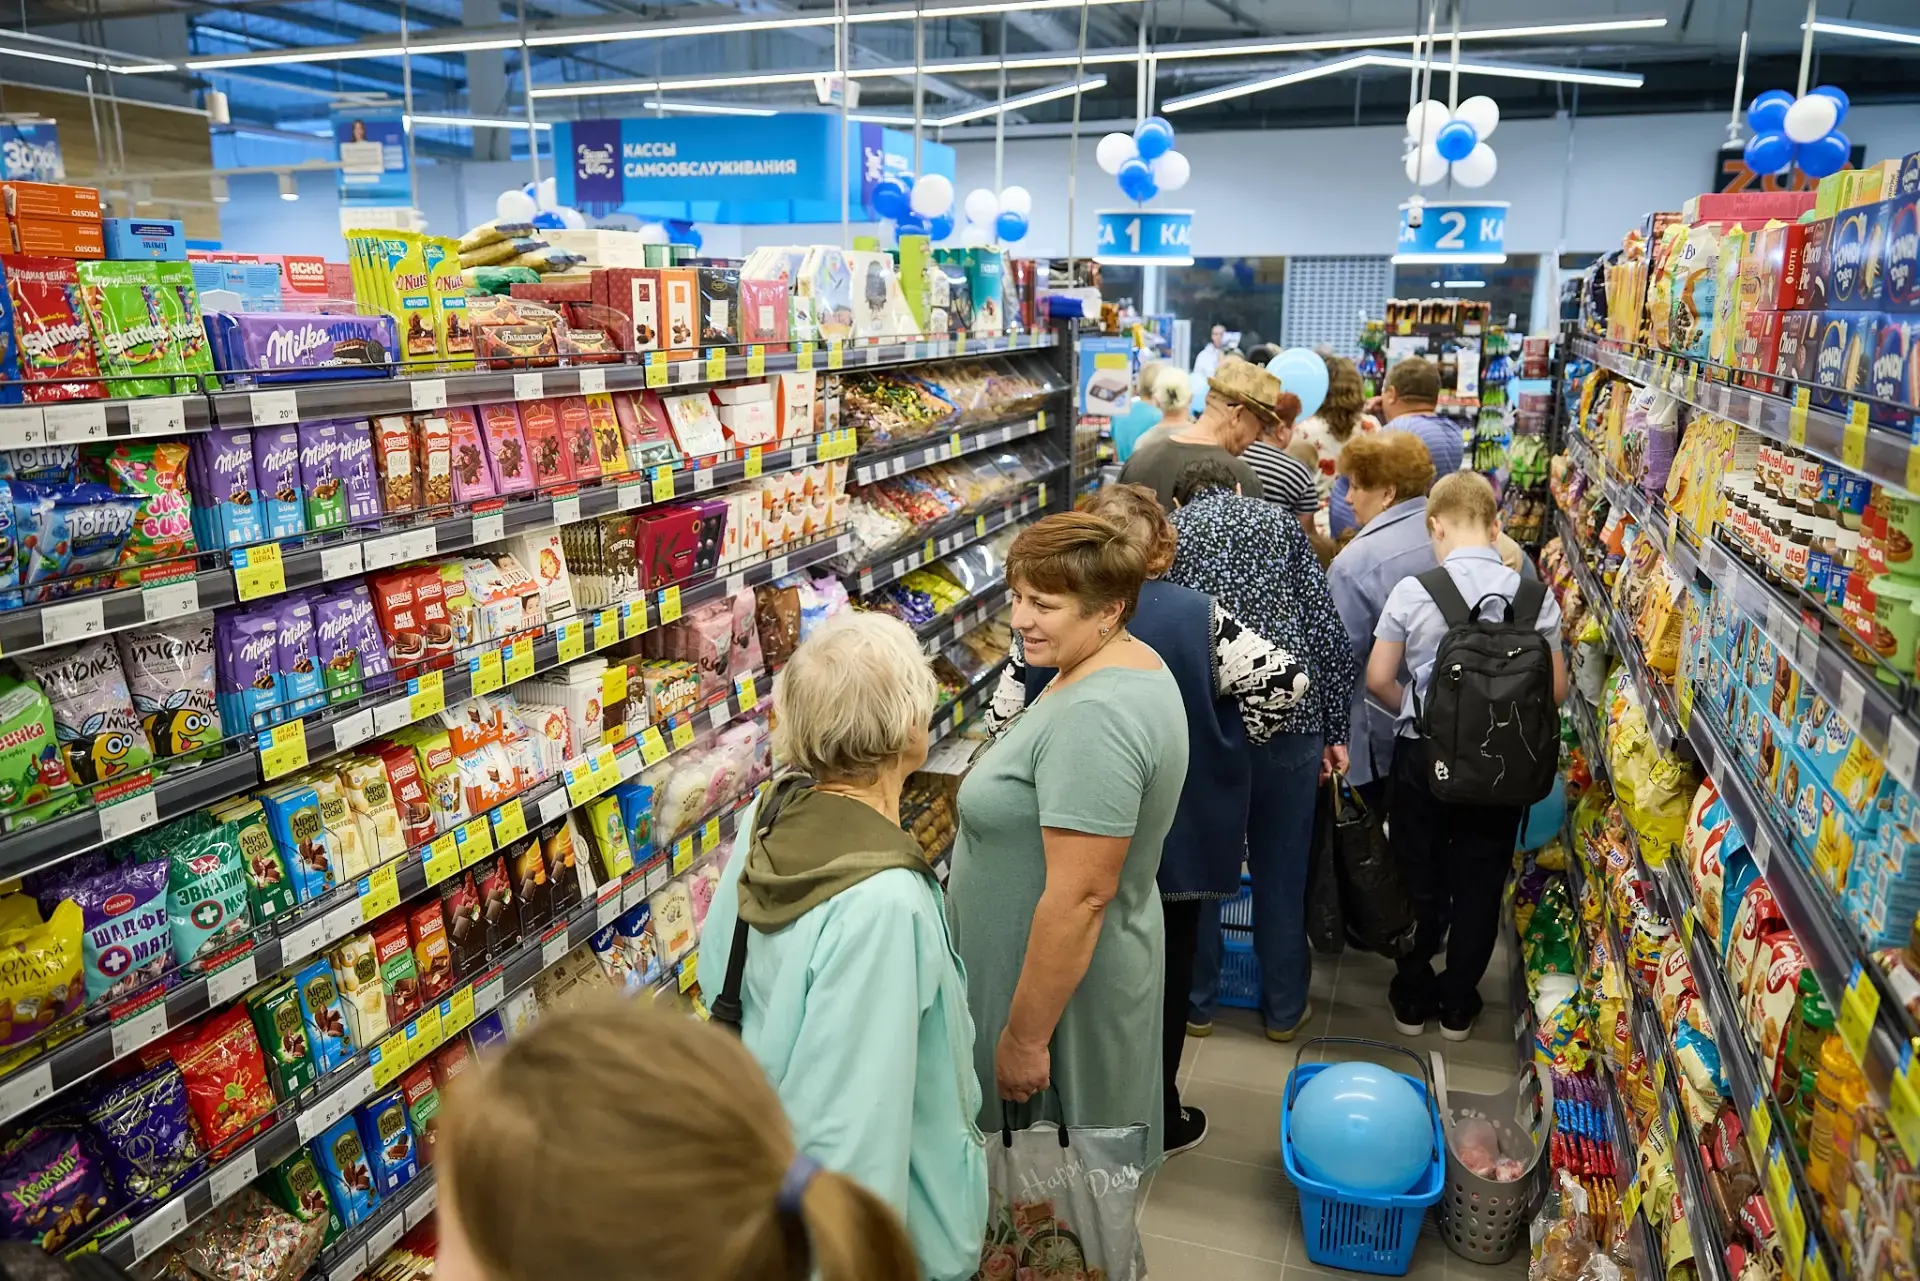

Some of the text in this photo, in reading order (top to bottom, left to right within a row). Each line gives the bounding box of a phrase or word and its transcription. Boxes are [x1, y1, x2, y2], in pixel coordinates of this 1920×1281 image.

[623, 142, 676, 157] КАССЫ
[624, 159, 797, 178] САМООБСЛУЖИВАНИЯ
[71, 209, 98, 218] PROSTO
[1126, 218, 1140, 253] 1
[1436, 211, 1466, 249] 2
[75, 245, 101, 253] PROSTO
[1803, 242, 1822, 265] Choco
[1834, 242, 1861, 272] TONDI
[1888, 233, 1919, 270] TONDI
[289, 261, 324, 275] ЯСНО
[1787, 247, 1797, 276] LOTTE
[404, 273, 428, 292] Nuts
[443, 273, 464, 292] Nuts
[1799, 267, 1811, 290] Pie
[22, 322, 89, 355] Skittles
[105, 323, 168, 355] Skittles
[267, 322, 329, 365] Milka
[1742, 328, 1758, 355] Choco
[1779, 331, 1798, 354] Choco
[1818, 346, 1843, 373] TONDI
[1873, 353, 1904, 384] TONDI
[336, 437, 372, 461] Milka
[384, 436, 410, 450] Nestlé
[427, 436, 450, 450] Nestlé
[214, 448, 253, 474] Milka
[263, 447, 298, 473] Milka
[300, 440, 337, 468] Milka
[64, 508, 132, 539] Toffix
[74, 538, 101, 549] CENTER
[610, 539, 636, 553] TRUFFLES
[386, 590, 413, 609] Nestlé
[416, 582, 442, 600] Nestlé
[444, 582, 466, 598] Nestlé
[395, 610, 412, 621] MILK
[425, 602, 442, 613] MILK
[279, 620, 312, 647] Milka
[318, 612, 353, 641] Milka
[240, 635, 276, 662] Milka
[657, 678, 697, 710] Toffifee
[429, 750, 453, 767] Nestlé
[391, 763, 416, 780] Nestlé
[364, 781, 387, 796] Alpen
[367, 790, 387, 803] Gold
[401, 781, 418, 793] MILK
[320, 797, 344, 812] Alpen
[323, 806, 343, 820] Gold
[292, 813, 319, 830] Alpen
[295, 823, 319, 839] Gold
[241, 830, 268, 847] Alpen
[245, 840, 269, 856] Gold
[91, 908, 168, 949] ШАЛФЕ
[420, 917, 443, 937] Nestlé
[132, 930, 172, 962] МЯТ
[381, 936, 407, 958] Nestlé
[355, 957, 375, 972] Alpen
[358, 966, 376, 980] Gold
[388, 961, 414, 980] HAZELNUT
[306, 981, 333, 998] Alpen
[356, 978, 382, 996] AERATED
[310, 991, 333, 1008] Gold
[276, 1005, 298, 1024] Alpen
[279, 1016, 298, 1033] Gold
[407, 1076, 433, 1098] Nestlé
[417, 1098, 440, 1120] HAZELNUT
[379, 1111, 402, 1130] Alpen
[382, 1121, 402, 1135] Gold
[382, 1125, 407, 1146] OREO
[334, 1135, 358, 1156] Alpen
[338, 1146, 361, 1165] Gold
[290, 1163, 313, 1183] Alpen
[294, 1172, 314, 1192] Gold
[1019, 1158, 1142, 1200] Happy Day
